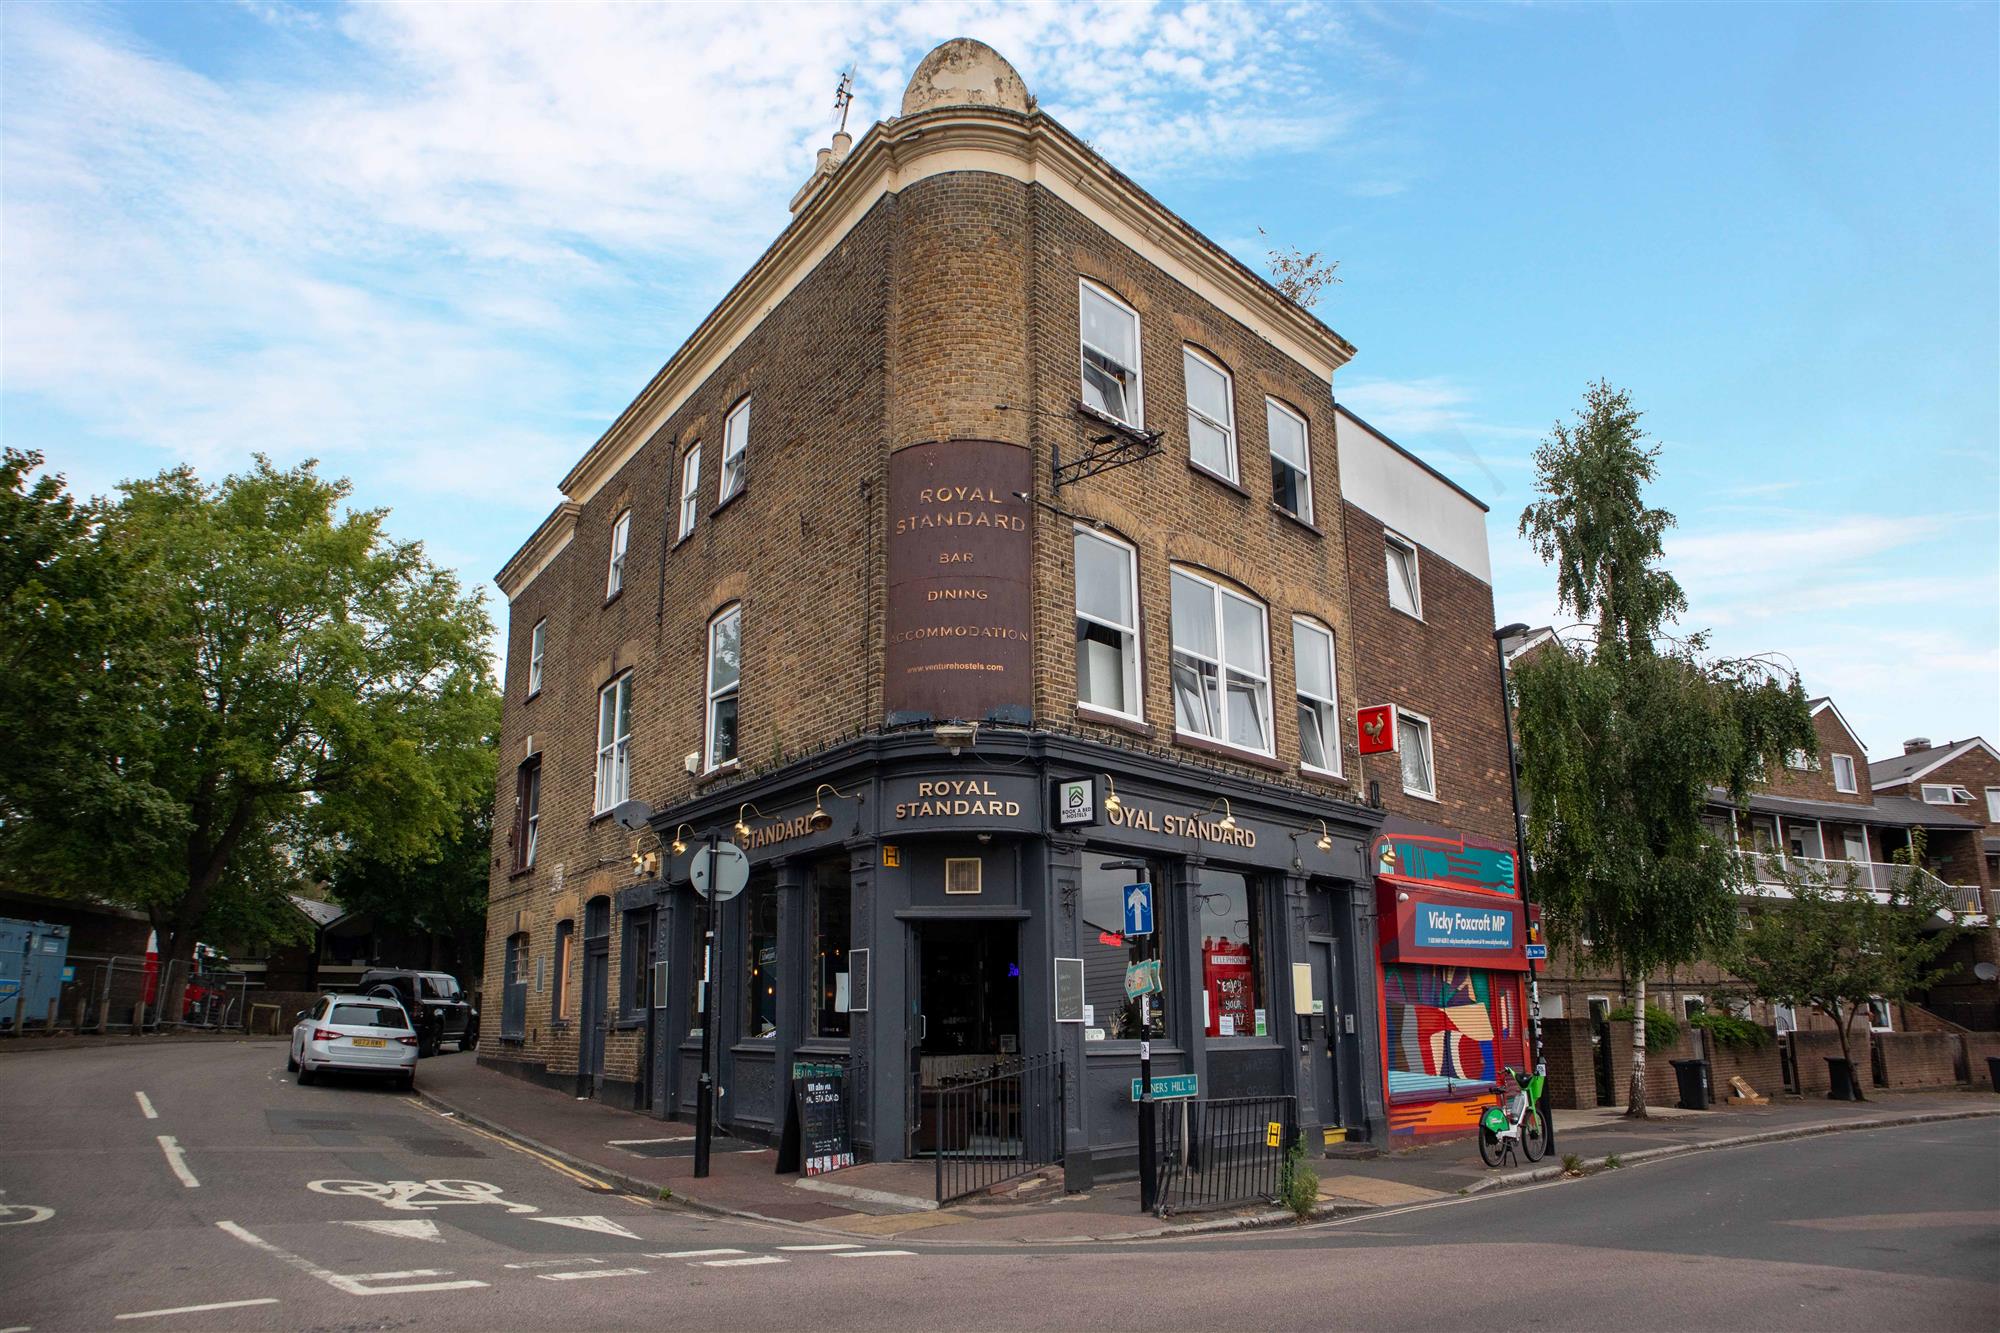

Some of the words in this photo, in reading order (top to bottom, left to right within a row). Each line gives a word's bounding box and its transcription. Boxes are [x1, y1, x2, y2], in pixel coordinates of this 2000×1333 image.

[920, 486, 1002, 505] ROYAL
[896, 511, 1026, 536] STANDARD
[939, 552, 974, 564] BAR
[928, 589, 988, 602] DINING
[891, 626, 1029, 644] ACCOMMODATION
[919, 780, 997, 797] ROYAL
[896, 800, 1021, 819] STANDARD
[1109, 806, 1160, 833] OYAL
[1163, 814, 1256, 848] STANDARD
[885, 848, 898, 865] H
[1428, 911, 1453, 934] Vicky
[1455, 913, 1491, 932] Foxcroft
[1492, 915, 1506, 932] MP
[1135, 1082, 1168, 1095] TNERS
[1171, 1081, 1186, 1092] HILL
[1268, 1125, 1280, 1144] H
